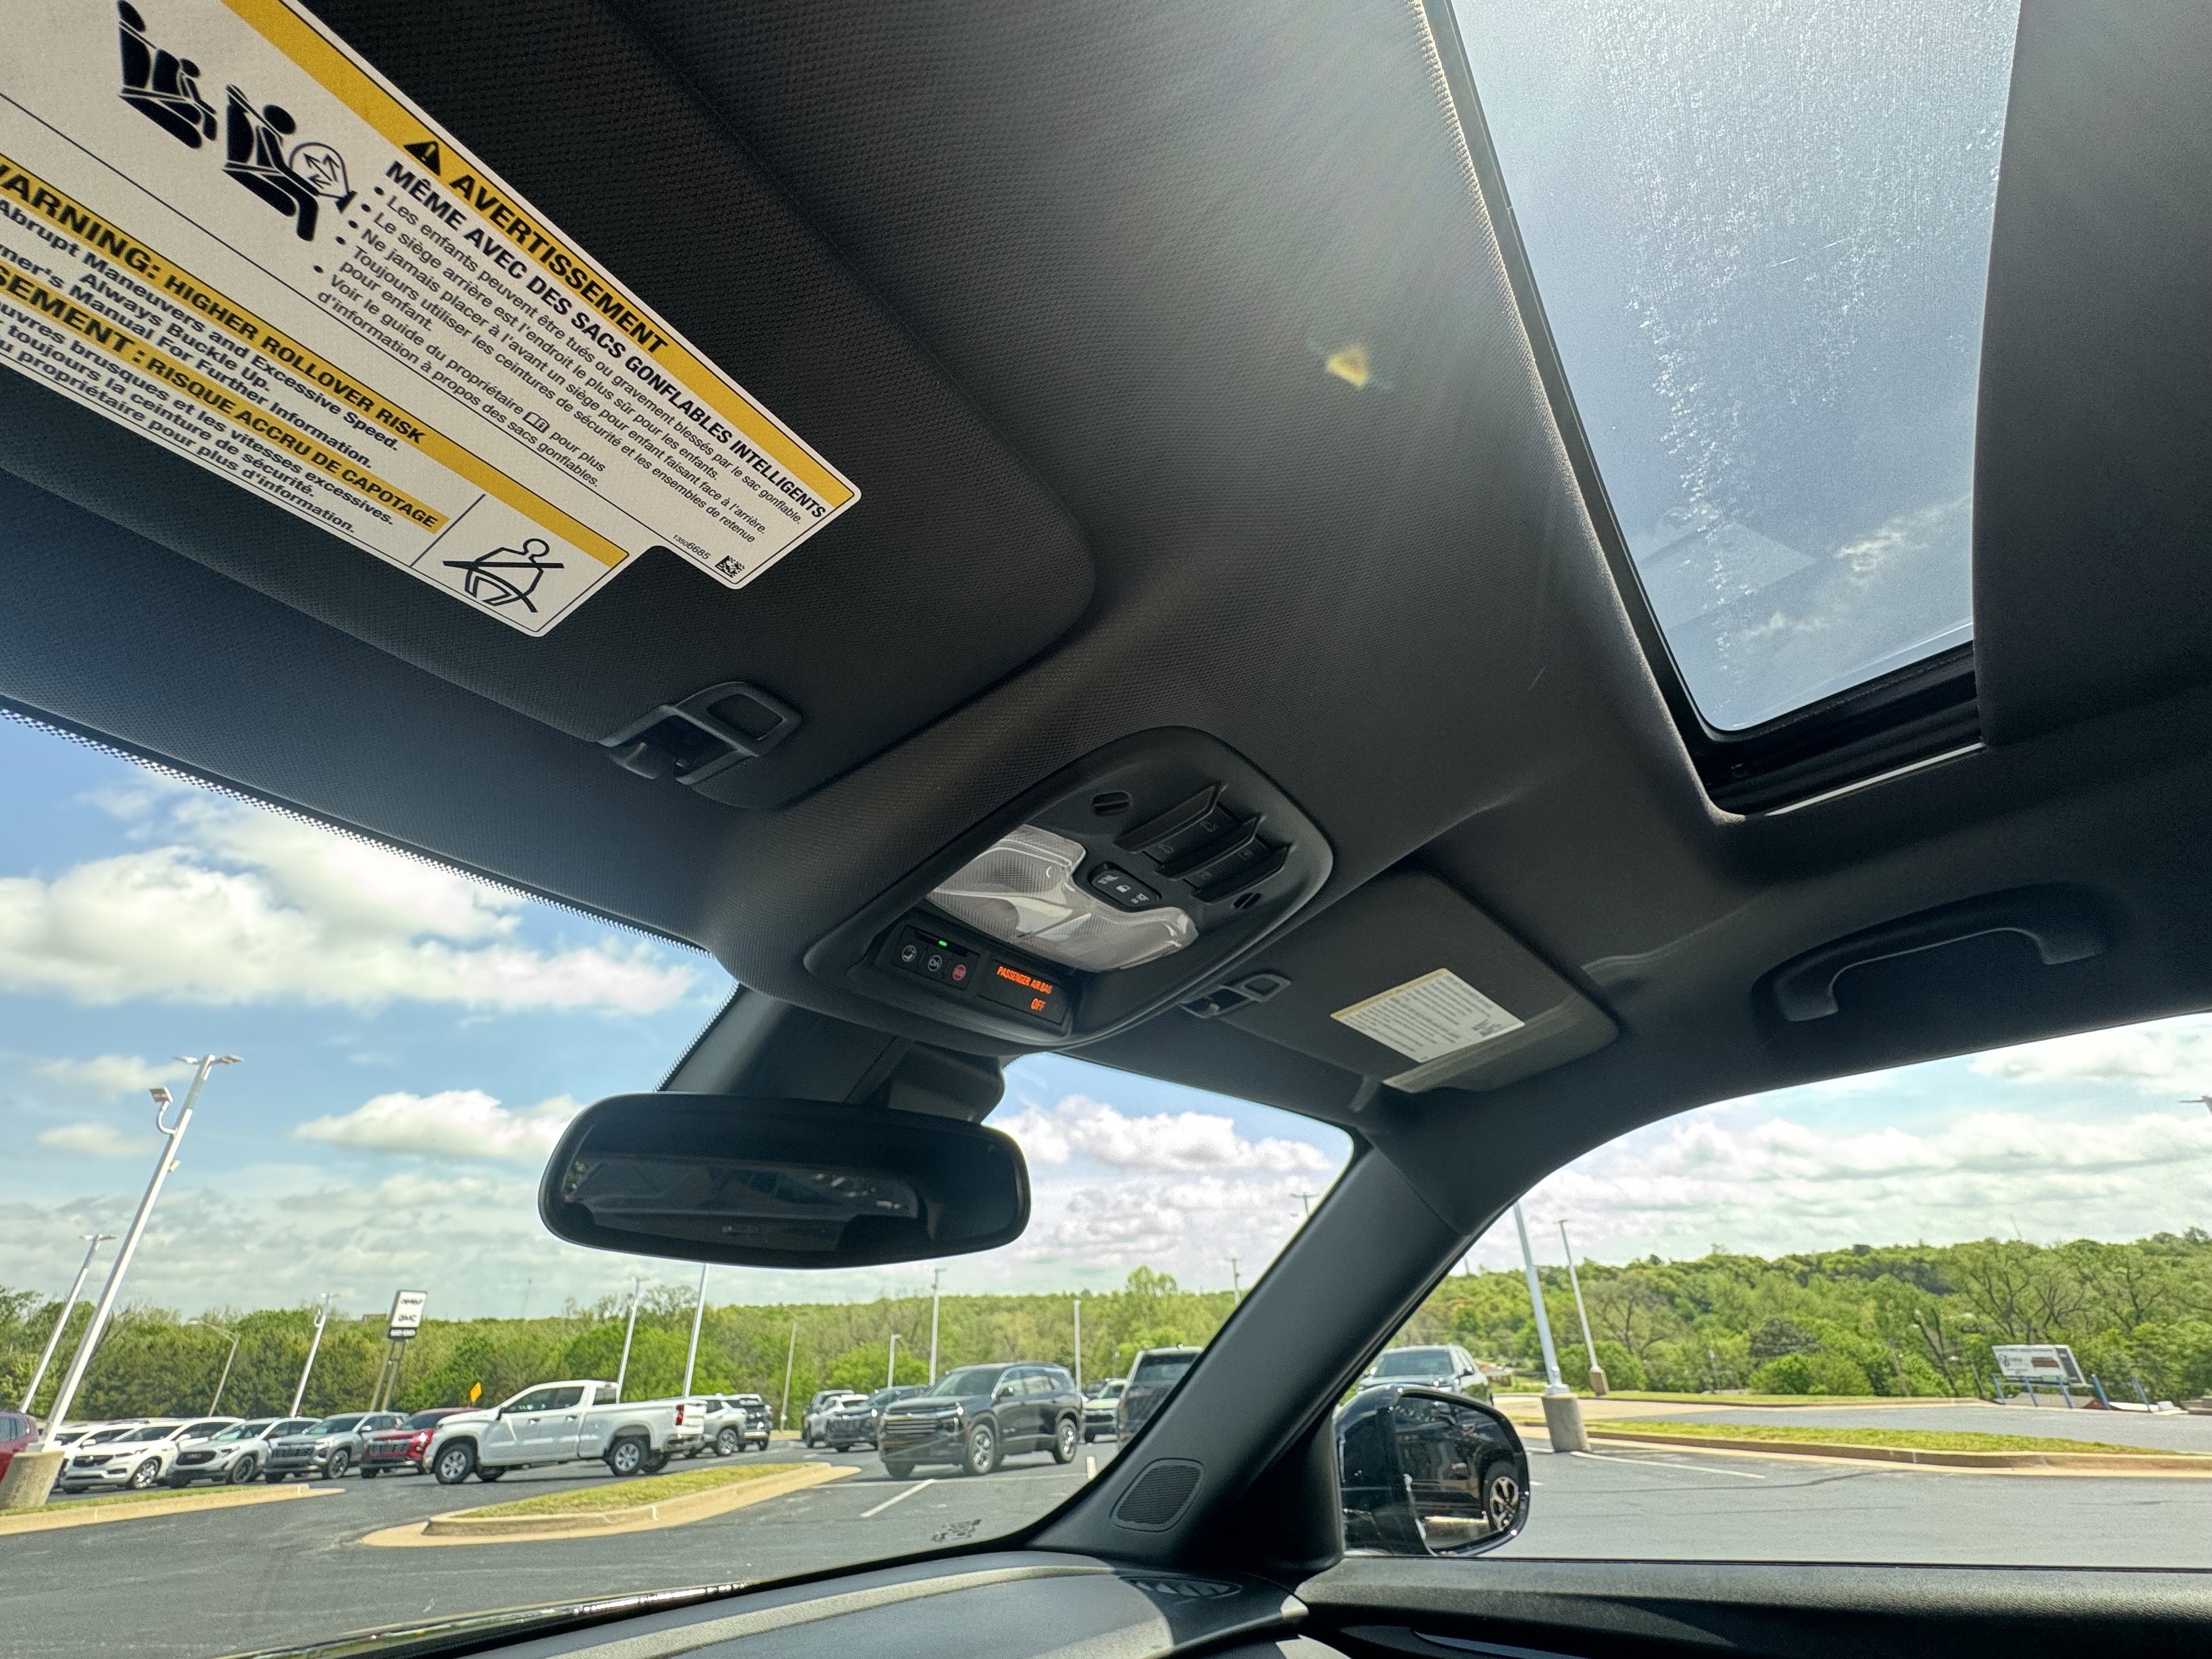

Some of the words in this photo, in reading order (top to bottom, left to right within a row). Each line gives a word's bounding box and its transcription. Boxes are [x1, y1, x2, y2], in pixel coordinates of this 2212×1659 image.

[0, 163, 161, 280] ARNING:
[162, 274, 259, 341] HIGHER
[259, 335, 375, 413] ROLLOVER
[374, 407, 426, 444] RISK
[0, 199, 80, 257] Abrupt
[82, 251, 206, 332] Maneuvers
[207, 331, 250, 359] and
[250, 354, 341, 414] Excessive
[342, 411, 398, 451] Speed.
[0, 244, 65, 289] ner's
[67, 284, 155, 340] Manual
[156, 335, 194, 361] For
[194, 358, 269, 405] Further
[268, 401, 371, 469] Information.
[78, 273, 163, 326] Always
[165, 322, 238, 370] Buckle
[240, 366, 270, 392] Up.
[338, 261, 381, 291] pour
[381, 290, 432, 331] enfant.
[373, 211, 397, 234] Le
[397, 233, 442, 269] siège
[442, 267, 493, 307] arrière
[493, 306, 518, 327] est
[517, 322, 573, 369] l'endroit
[572, 364, 586, 379] le
[584, 376, 614, 399] plus
[613, 398, 636, 415] sûr
[631, 414, 663, 435] pour
[661, 432, 679, 449] les
[678, 448, 718, 480] enfants.
[385, 160, 467, 231] MÊME
[462, 227, 528, 279] AVEC
[525, 274, 573, 315] DES
[570, 311, 627, 358] SACS
[624, 355, 733, 444] GONFLABLES
[729, 439, 826, 518] INTELLIGENTS
[386, 195, 419, 225] Les
[419, 224, 478, 272] enfants
[476, 269, 538, 318] peuvent
[537, 314, 565, 339] être
[565, 336, 595, 363] tués
[594, 361, 613, 377] ou
[611, 375, 675, 425] gravement
[673, 421, 714, 455] blessés
[710, 453, 733, 469] par
[730, 465, 743, 477] le
[741, 475, 761, 491] sac
[758, 489, 801, 524] gonflable.
[448, 174, 669, 353] AVERTISSEMENT
[0, 302, 66, 344] uvres
[69, 339, 170, 401] brusques
[172, 399, 195, 415] et
[196, 410, 227, 432] les
[230, 429, 303, 473] vitesses
[304, 471, 393, 525] excessives.
[7, 324, 101, 381] toujours
[104, 377, 126, 395] la
[129, 393, 212, 441] ceinture
[214, 438, 239, 455] de
[241, 453, 314, 497] sécurité.
[16, 350, 145, 421] propriétaire
[147, 419, 196, 447] pour
[196, 445, 239, 470] plus
[241, 469, 354, 533] d'information.
[145, 357, 236, 414] RISQUE
[233, 409, 312, 455] ACCRU
[310, 450, 342, 473] DE
[341, 469, 438, 528] CAPOTAGE
[317, 291, 419, 364] d'information
[420, 360, 432, 373] à
[431, 370, 481, 405] propos
[481, 404, 507, 423] des
[506, 421, 538, 444] sacs
[536, 442, 598, 487] gonflables.
[330, 274, 363, 301] Voir
[363, 298, 380, 315] le
[379, 313, 424, 346] guide
[425, 344, 447, 361] du
[444, 359, 524, 414] propriétaire
[548, 431, 581, 453] pour
[577, 452, 606, 472] plus
[353, 245, 419, 301] Toujours
[420, 298, 472, 337] utiliser
[471, 334, 494, 355] les
[494, 353, 556, 399] ceintures
[555, 397, 573, 412] de
[573, 410, 623, 447] sécurité
[620, 445, 635, 457] et
[633, 453, 652, 469] les
[651, 467, 707, 508] ensembles
[705, 506, 720, 517] de
[718, 516, 755, 542] retenue
[360, 228, 386, 252] Ne
[383, 248, 441, 292] jamais
[439, 290, 489, 326] placer
[487, 324, 500, 337] à
[500, 332, 548, 372] l'avant
[546, 369, 566, 386] un
[565, 383, 600, 410] siège
[597, 409, 629, 431] pour
[627, 430, 665, 459] enfant
[663, 455, 701, 485] faisant
[698, 481, 722, 500] face
[720, 497, 730, 507] à
[728, 503, 765, 534] l'arrière.
[996, 966, 1031, 986] PASSENGER
[1030, 998, 1046, 1011] OFF
